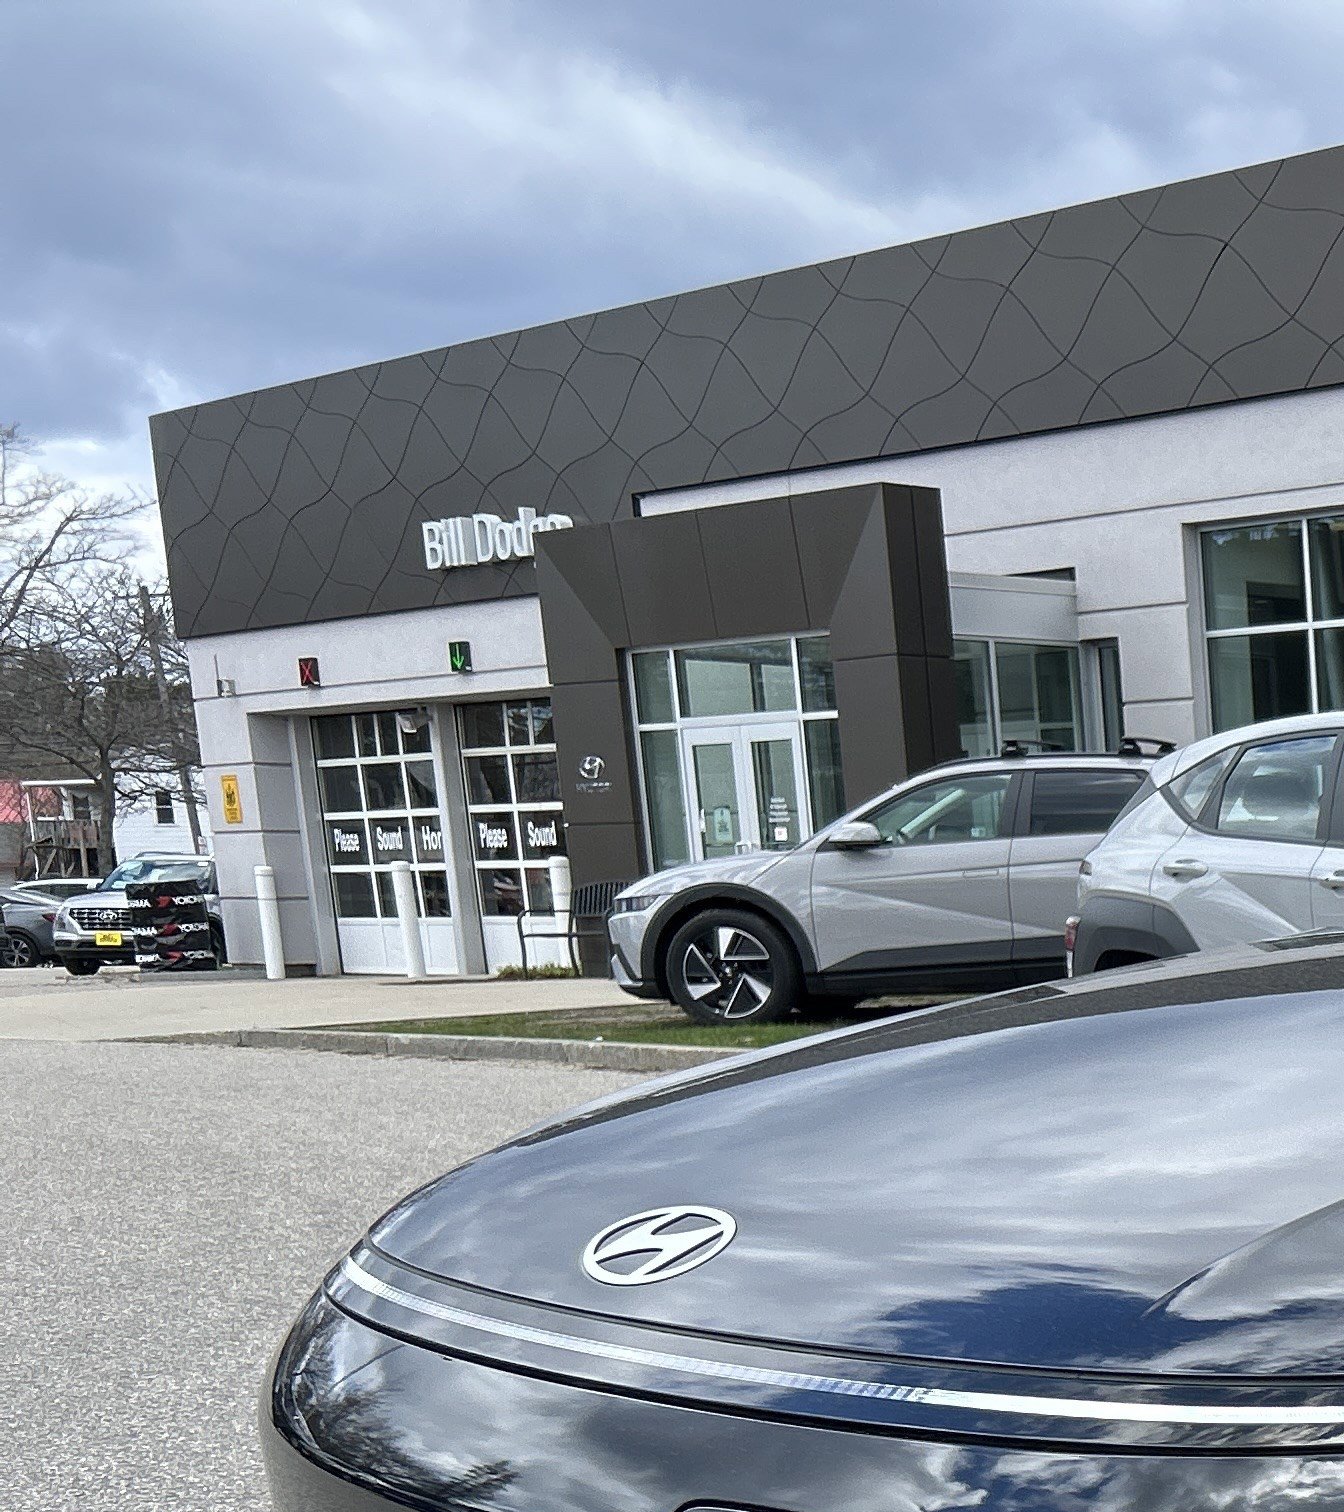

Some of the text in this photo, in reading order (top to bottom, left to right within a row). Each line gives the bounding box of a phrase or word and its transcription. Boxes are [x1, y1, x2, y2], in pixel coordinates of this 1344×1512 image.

[421, 516, 474, 570] Bill
[333, 826, 442, 852] Please Sound Hor
[479, 821, 557, 848] Please Sound
